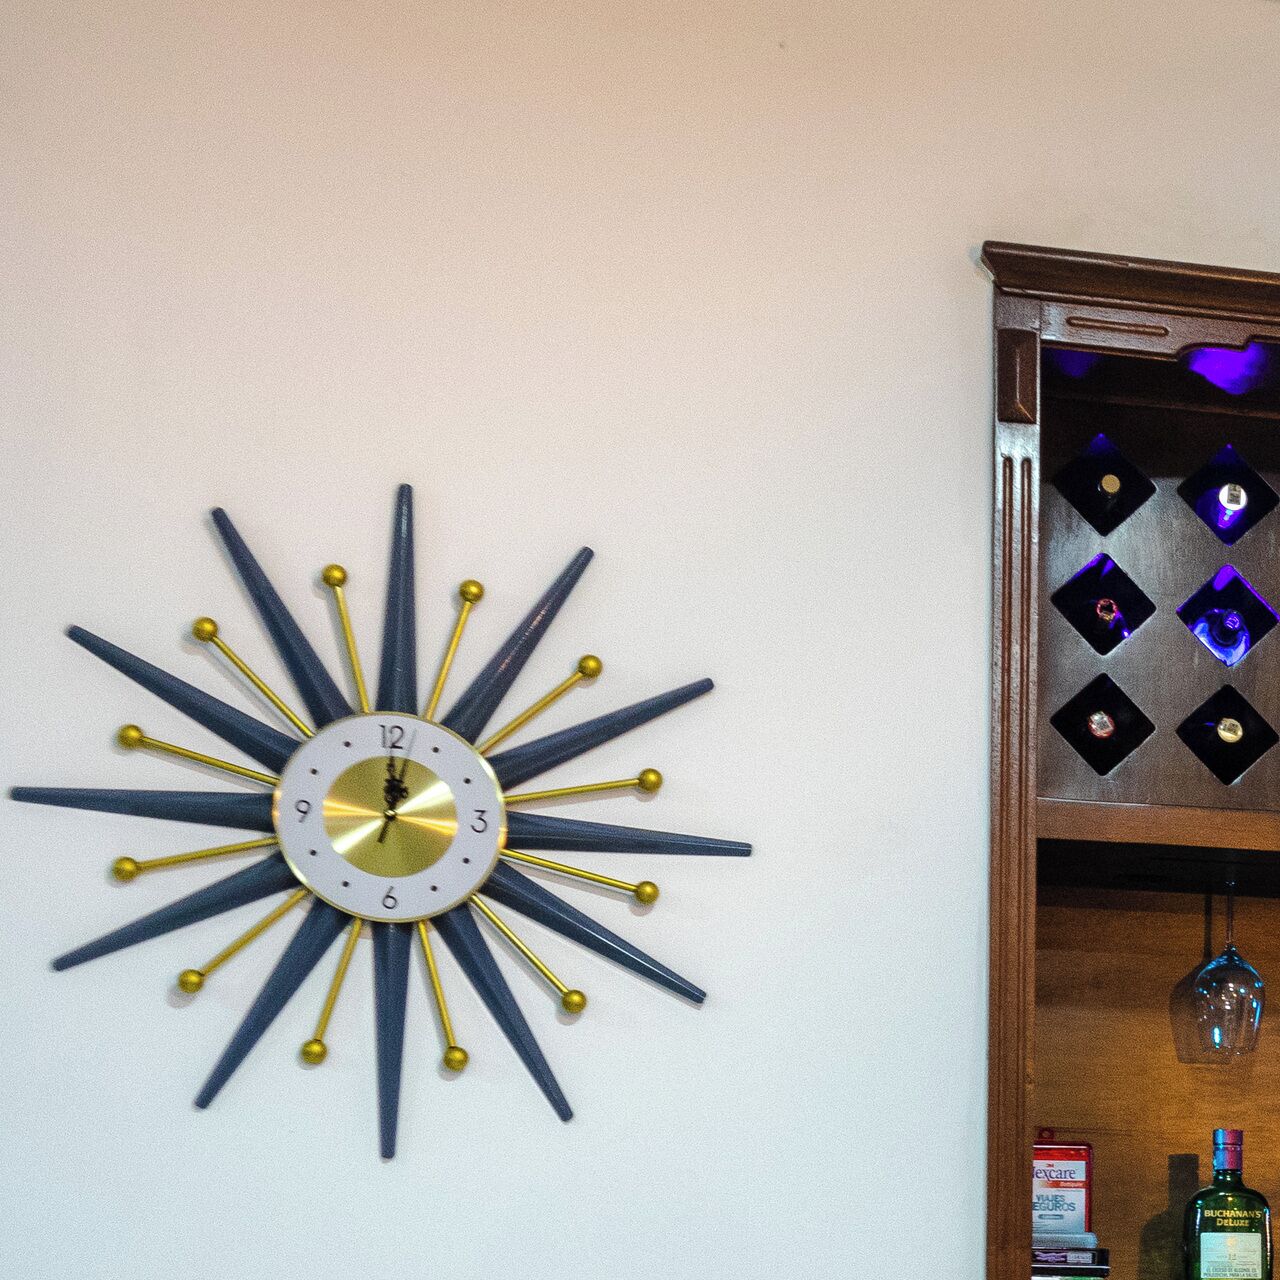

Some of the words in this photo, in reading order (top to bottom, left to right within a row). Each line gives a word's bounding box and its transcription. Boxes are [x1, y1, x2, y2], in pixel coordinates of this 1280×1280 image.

[379, 724, 405, 750] 12
[294, 799, 312, 823] 9
[470, 809, 488, 834] 3
[382, 885, 399, 910] 6
[1032, 1201, 1076, 1212] EGUROS
[1036, 1194, 1065, 1203] VIAJES
[1204, 1209, 1263, 1219] BUCHANAN'S
